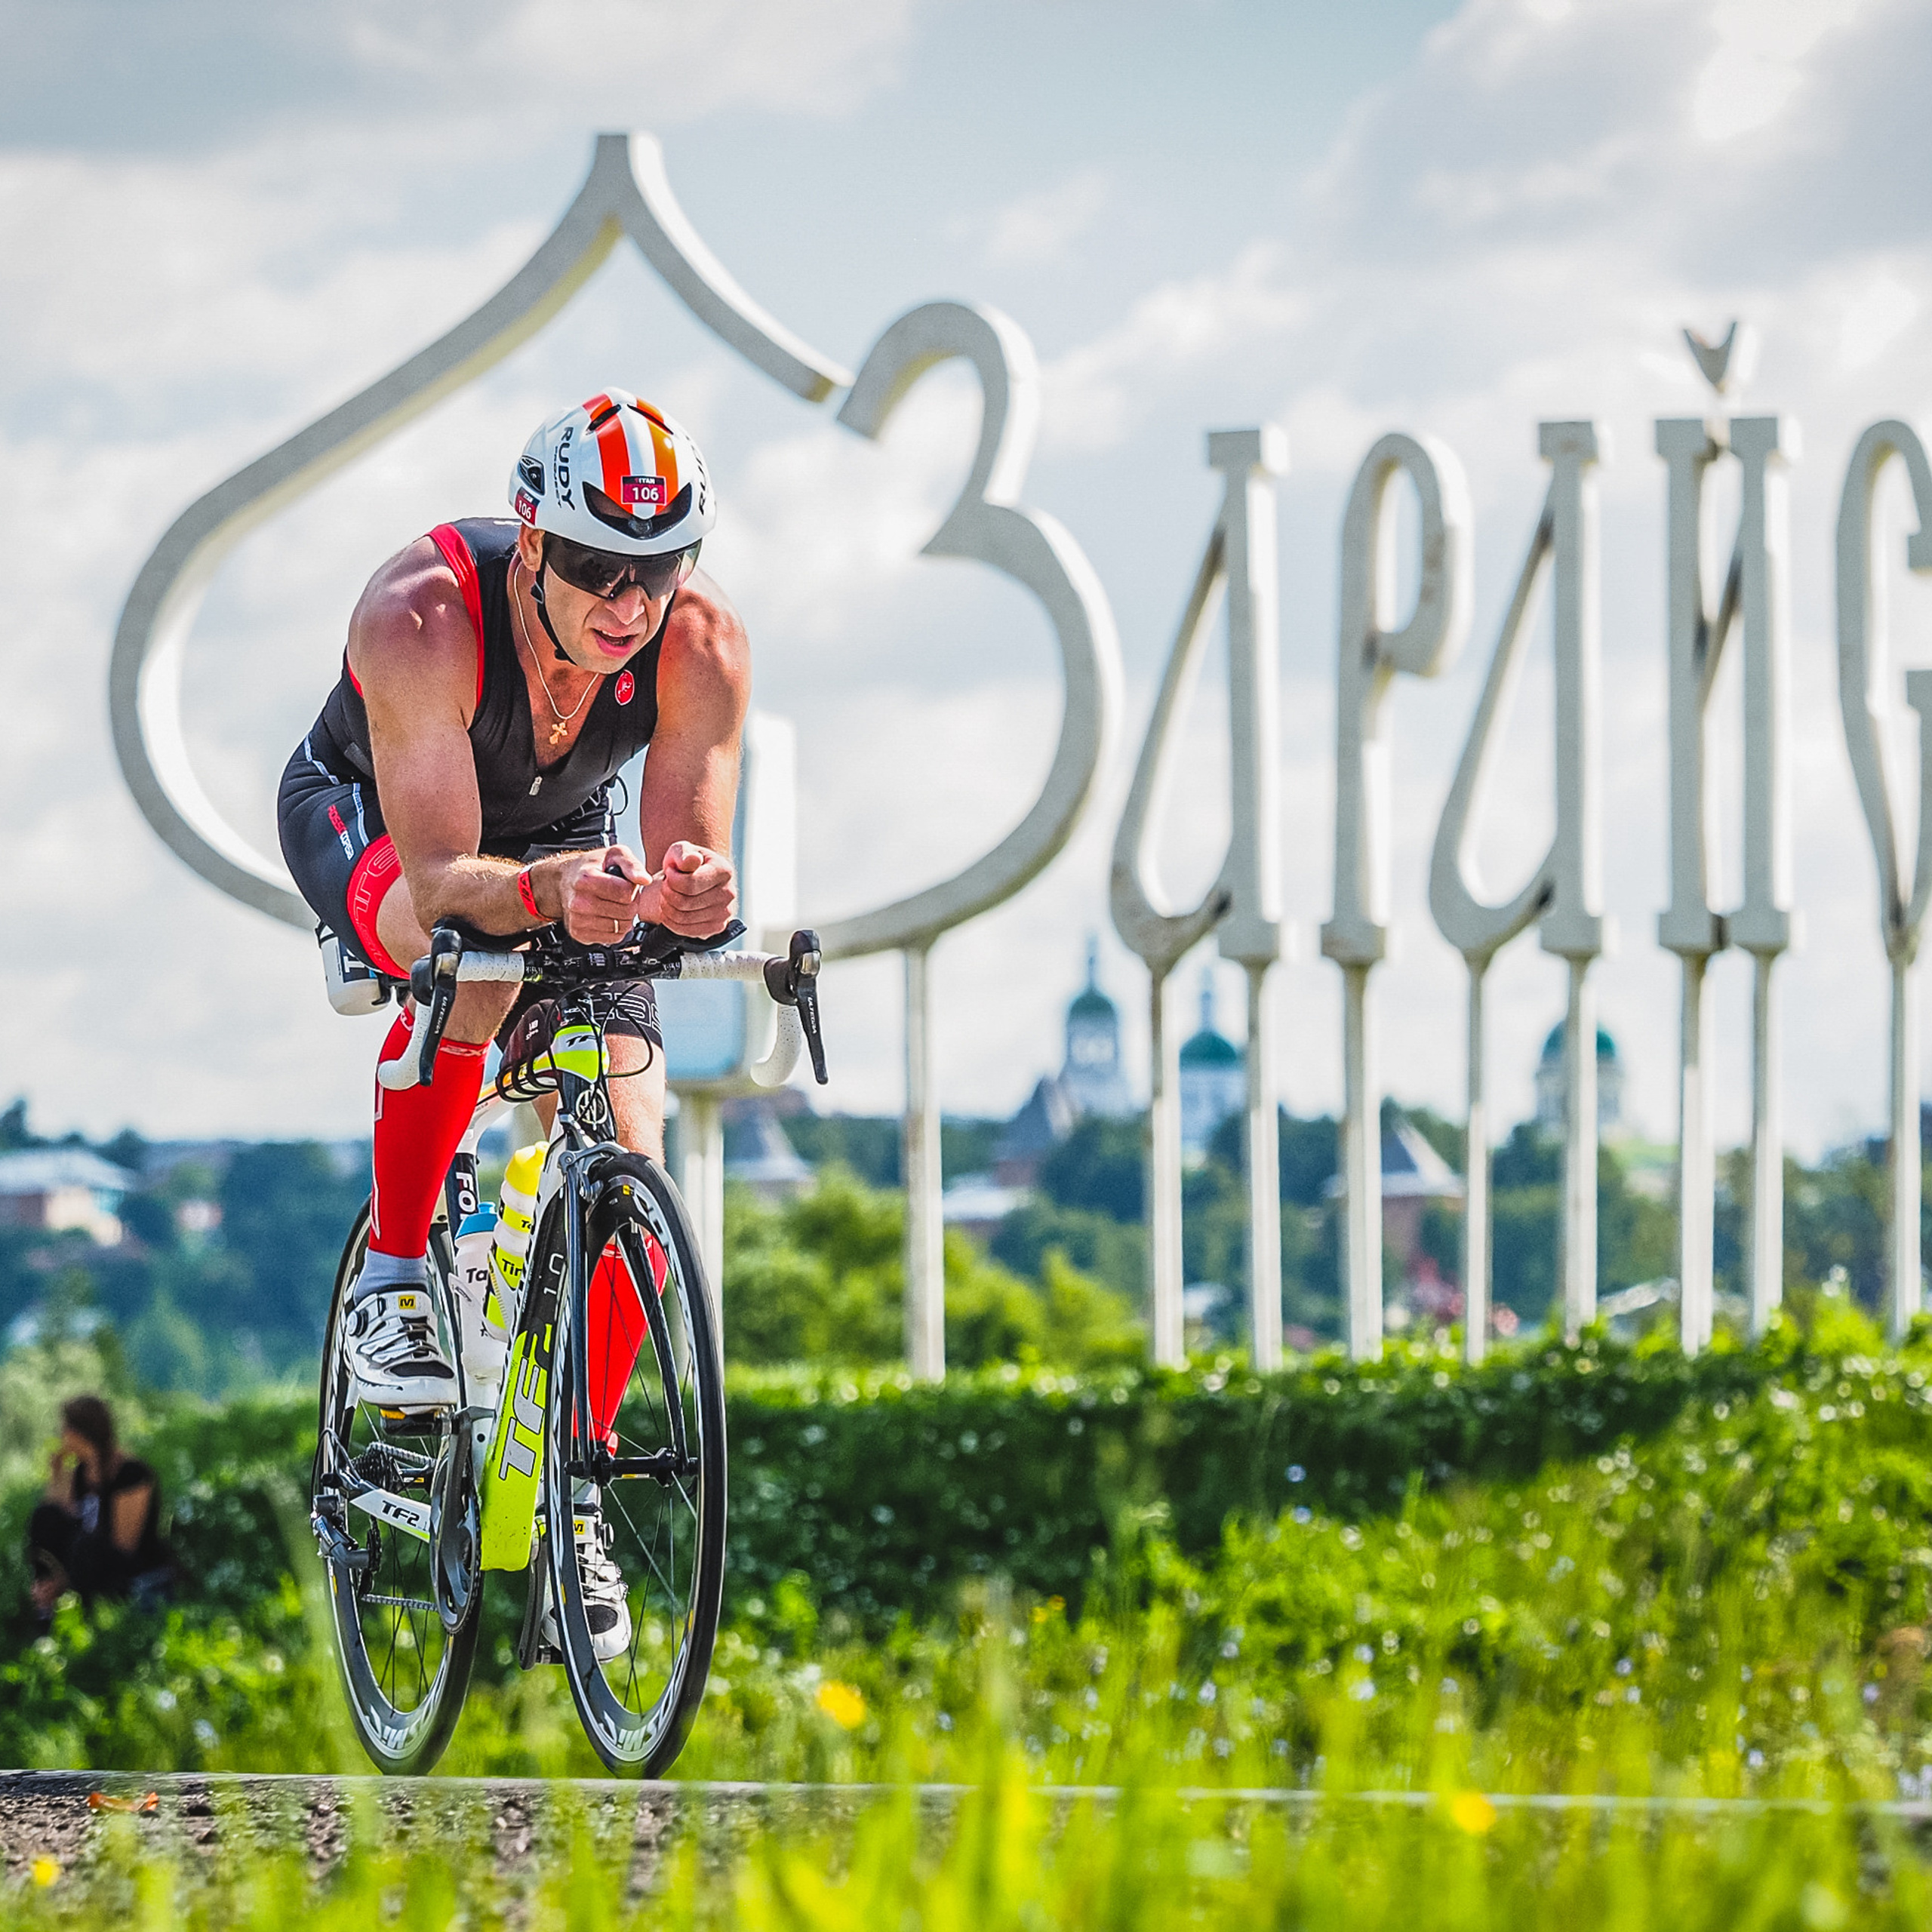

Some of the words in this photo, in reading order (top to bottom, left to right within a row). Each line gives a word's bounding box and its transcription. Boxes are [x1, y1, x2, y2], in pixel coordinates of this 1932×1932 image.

[558, 426, 575, 510] RUDY
[632, 487, 660, 501] 106
[518, 500, 532, 519] 106
[382, 1500, 420, 1527] TF2
